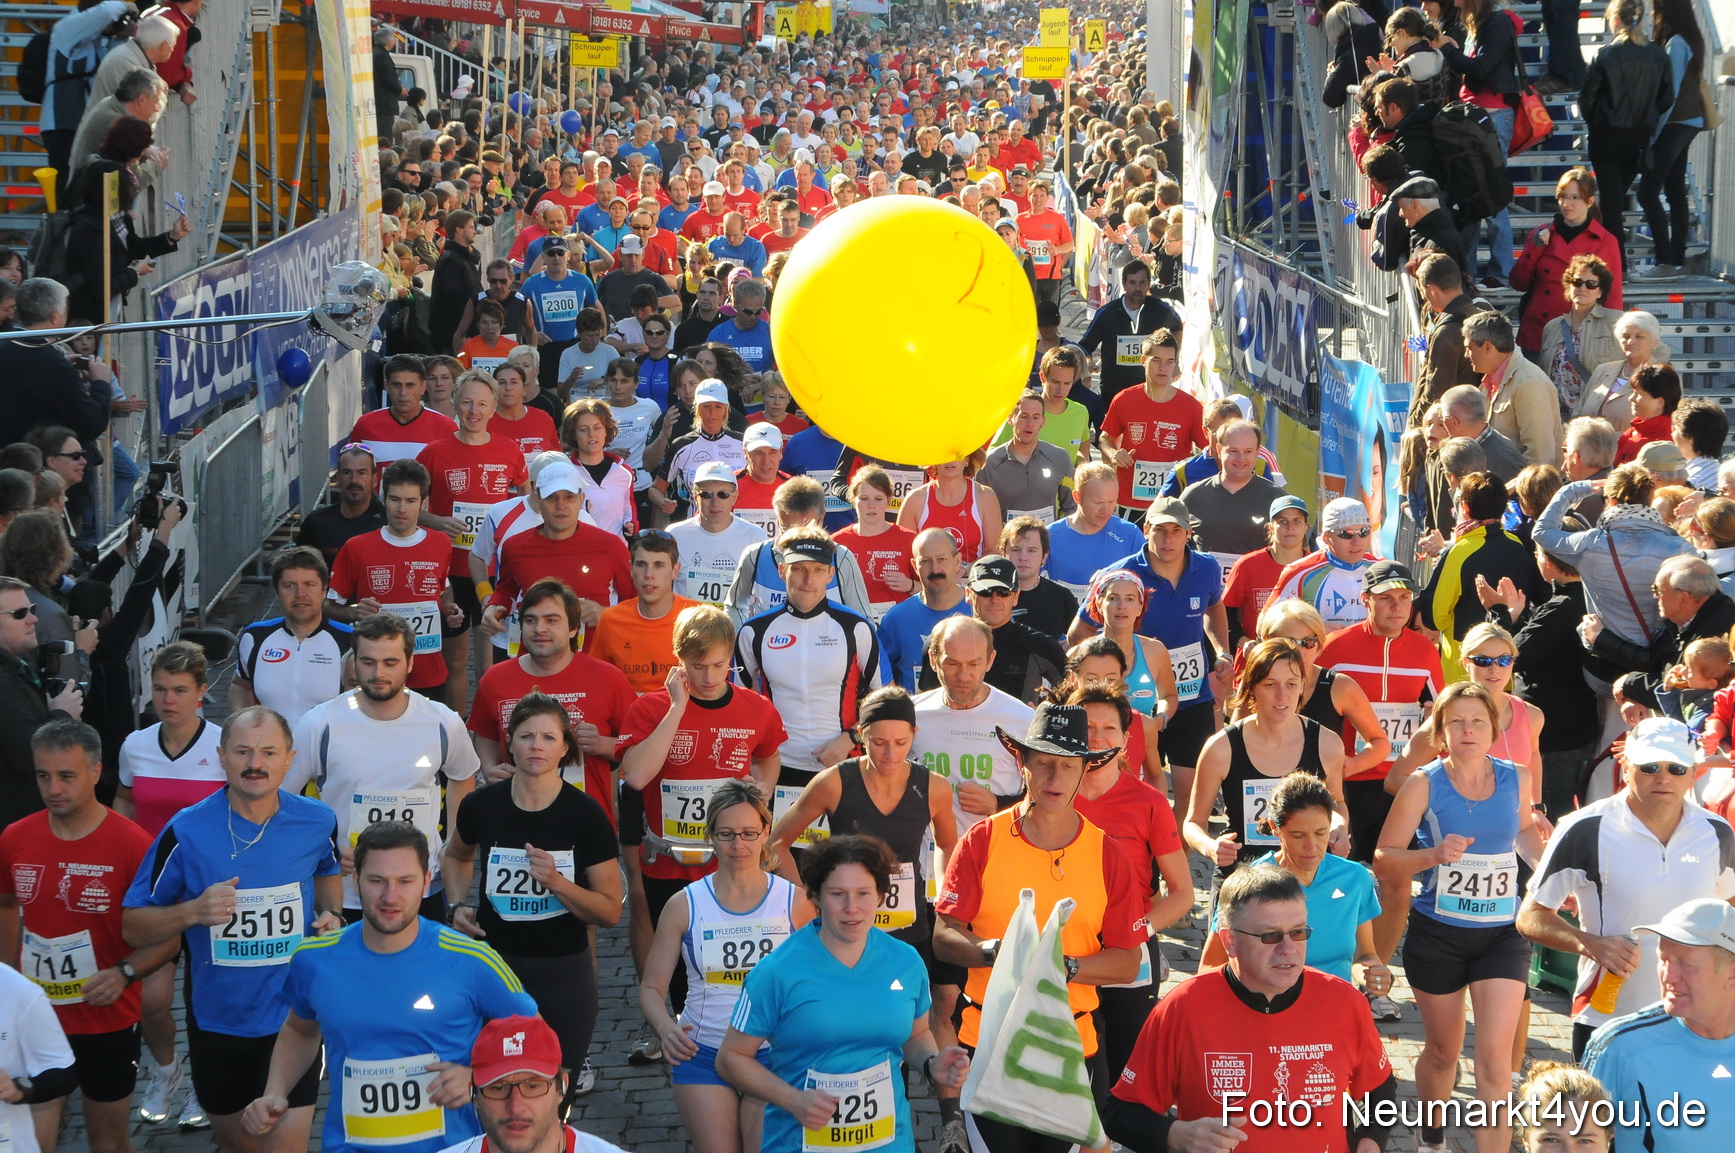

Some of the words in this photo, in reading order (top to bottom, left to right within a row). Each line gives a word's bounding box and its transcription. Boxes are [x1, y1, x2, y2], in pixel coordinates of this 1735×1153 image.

[473, 0, 491, 12] 6352
[612, 17, 632, 30] 6352
[780, 17, 791, 32] A
[1090, 30, 1101, 44] A
[574, 43, 615, 52] Schnupper-
[588, 52, 601, 60] lauf
[547, 298, 574, 312] 2300
[1125, 344, 1142, 355] 15
[1139, 472, 1168, 487] 231
[770, 635, 788, 644] tkn
[264, 648, 282, 658] tkn
[624, 664, 649, 673] EURO
[1052, 714, 1069, 725] riu
[960, 753, 993, 780] 09
[677, 822, 706, 835] Mar
[65, 868, 104, 877] STADTLAUF
[68, 863, 114, 872] NEUMARKTER
[496, 868, 564, 895] 220
[1447, 871, 1508, 897] 2413
[510, 897, 549, 914] Birgit
[1458, 898, 1496, 913] Maria
[222, 906, 294, 938] 2519
[715, 926, 752, 935] PFLEIDERER
[228, 940, 290, 958] Rüdiger
[32, 952, 78, 980] 714
[37, 980, 82, 996] ochen
[1281, 1044, 1333, 1053] NEUMARKTER
[1280, 1052, 1324, 1061] STADTLAUF
[1212, 1060, 1244, 1068] IMMER
[353, 1067, 394, 1076] PFLEIDERER
[1211, 1068, 1246, 1076] WIEDER
[818, 1080, 859, 1088] PFLEIDERER
[1213, 1077, 1244, 1088] NEU
[360, 1080, 421, 1114] 909
[831, 1123, 874, 1144] Birgit
